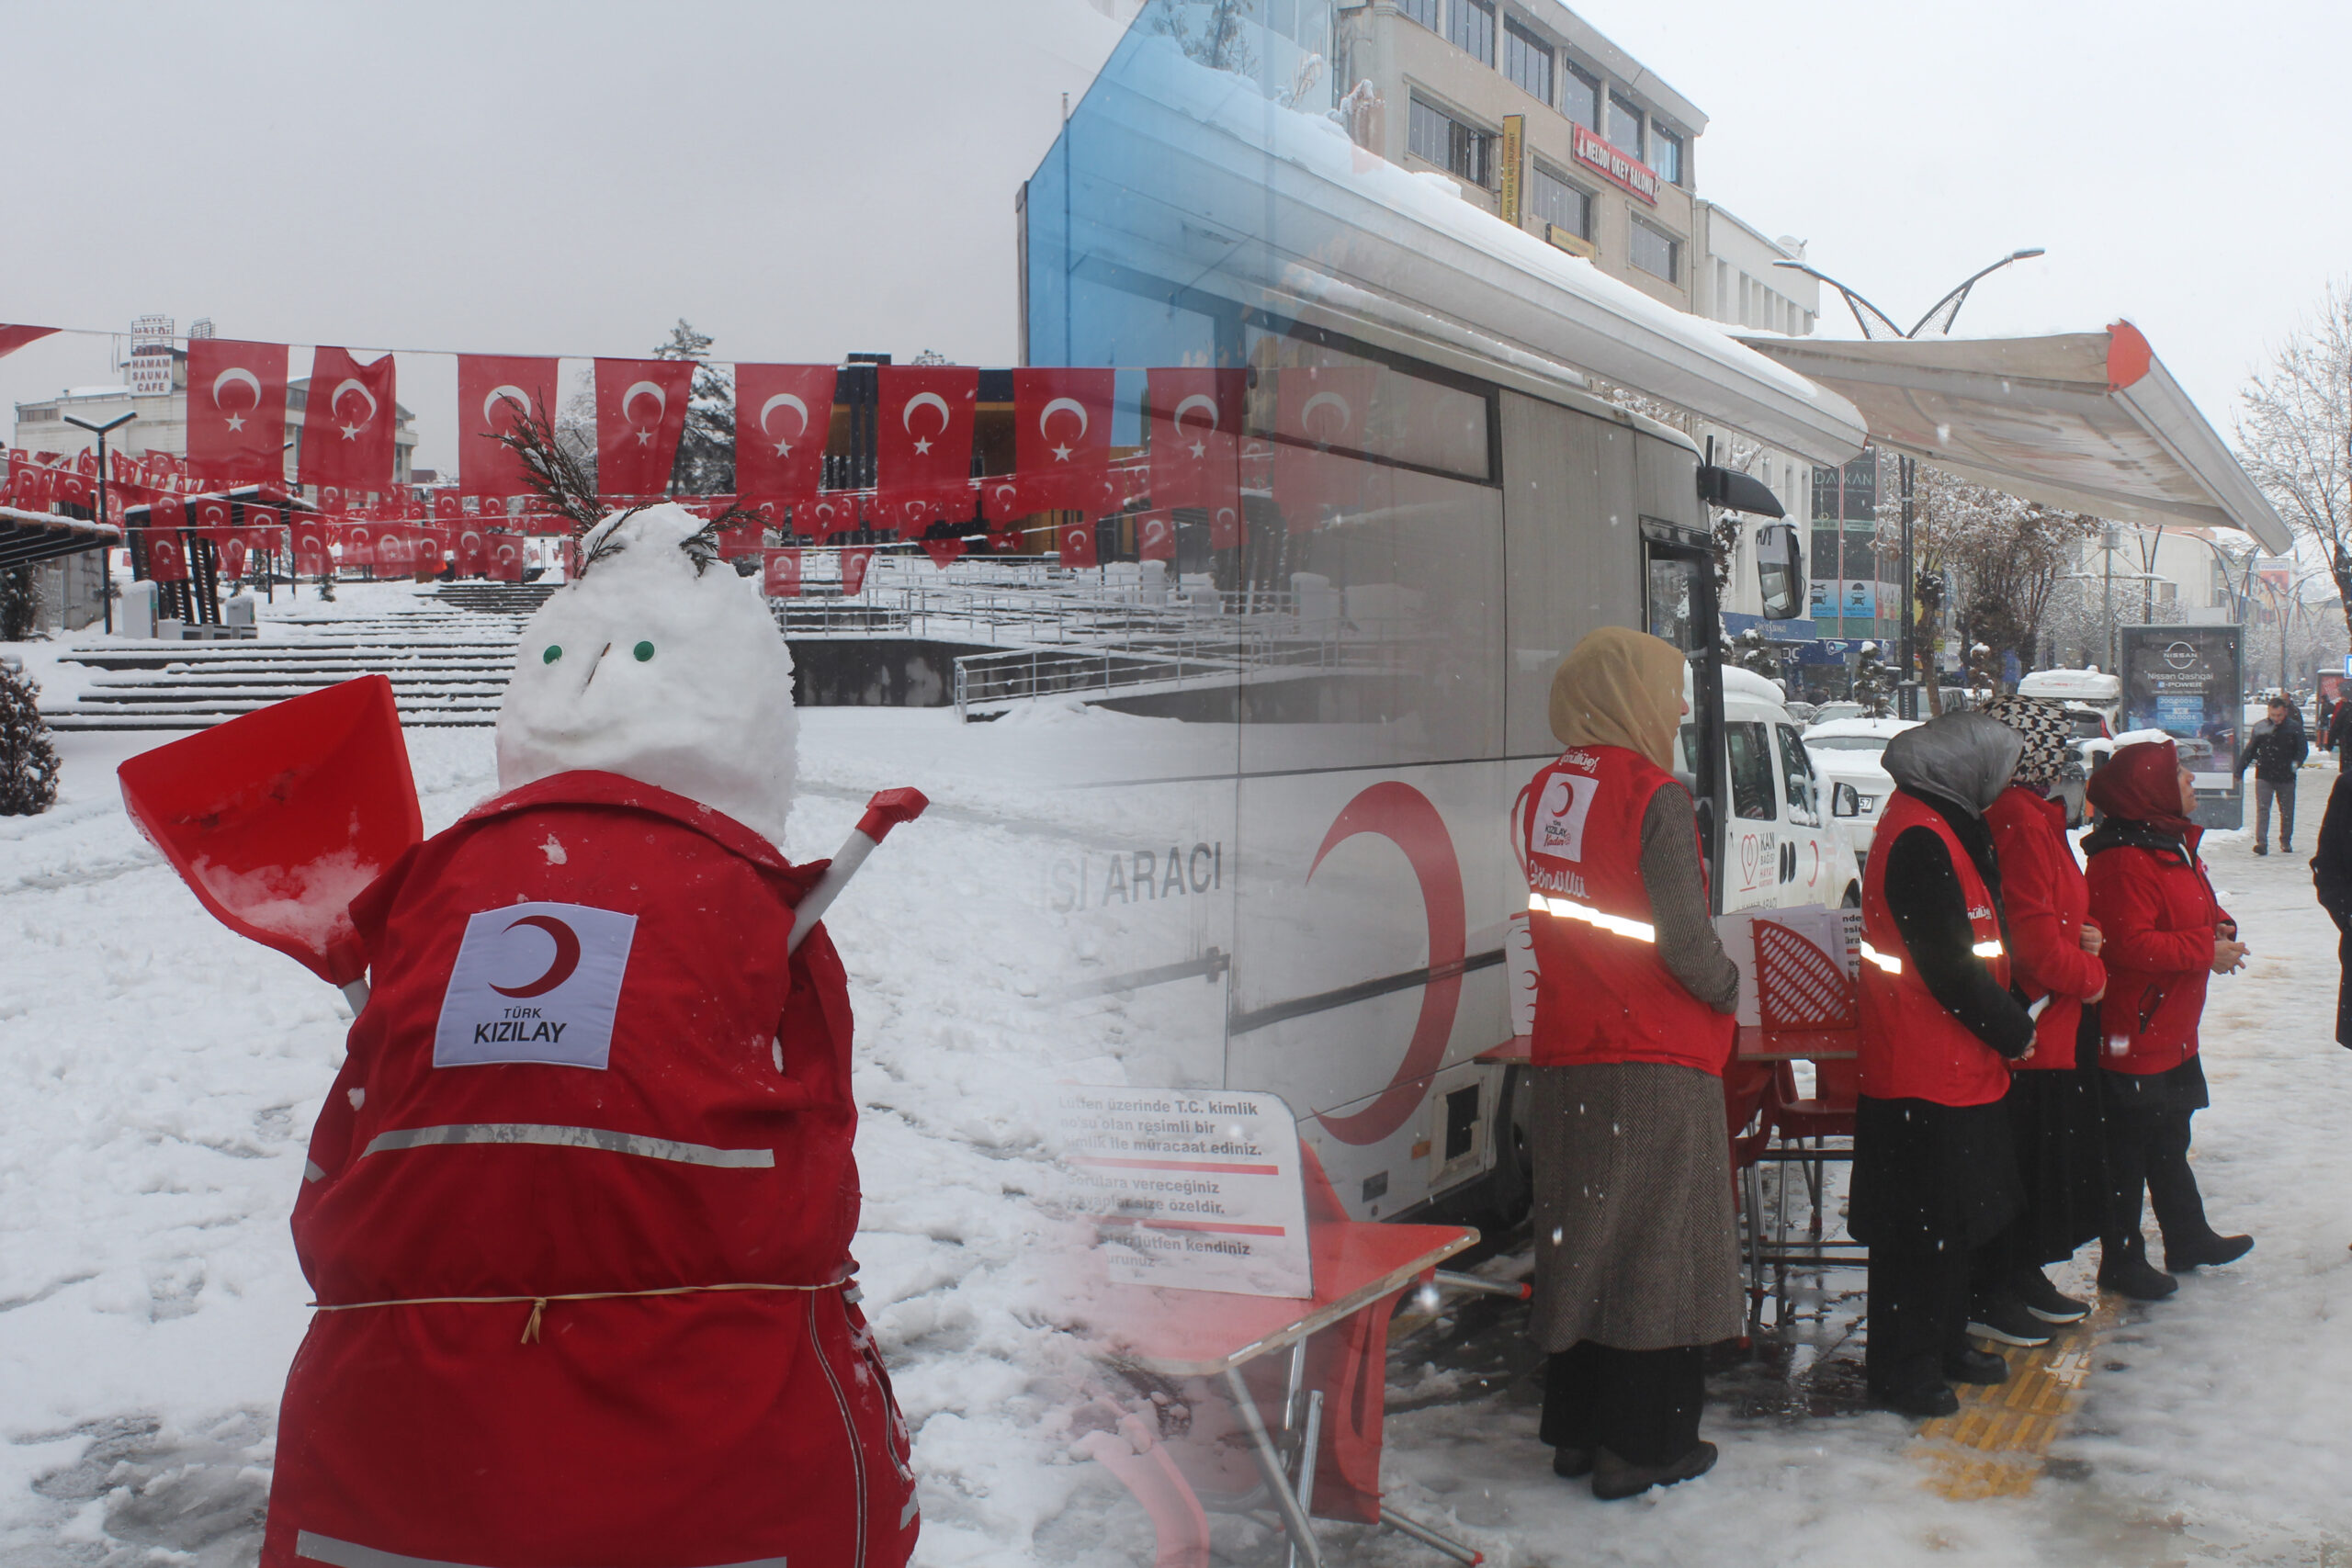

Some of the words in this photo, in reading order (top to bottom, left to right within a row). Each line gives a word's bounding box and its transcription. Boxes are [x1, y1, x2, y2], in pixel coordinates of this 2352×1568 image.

[1586, 139, 1611, 171] MELODİ
[1611, 154, 1630, 182] OKEY
[1630, 166, 1654, 197] SALONU
[132, 358, 171, 369] HAMAM
[132, 370, 170, 381] SAUNA
[137, 382, 165, 392] CAFE
[2177, 672, 2213, 682] Qashqai
[1859, 798, 1871, 808] 57
[1760, 831, 1775, 851] KAN
[1102, 841, 1221, 907] ARACI
[503, 1006, 542, 1019] TÜRK
[473, 1021, 567, 1044] KIZILAY
[1108, 1099, 1170, 1113] üzerinde
[1175, 1100, 1204, 1114] T.C.
[1208, 1101, 1259, 1115] kimlik
[1102, 1117, 1133, 1131] olan
[1137, 1119, 1190, 1134] resimli
[1194, 1121, 1216, 1134] bir
[1111, 1136, 1129, 1149] ile
[1134, 1138, 1206, 1154] müracaat
[1210, 1142, 1262, 1156] ediniz.
[1133, 1179, 1220, 1196] vereceğiniz
[1134, 1196, 1164, 1210] size
[1169, 1197, 1226, 1214] özeldir.
[1186, 1238, 1250, 1256] kendiniz
